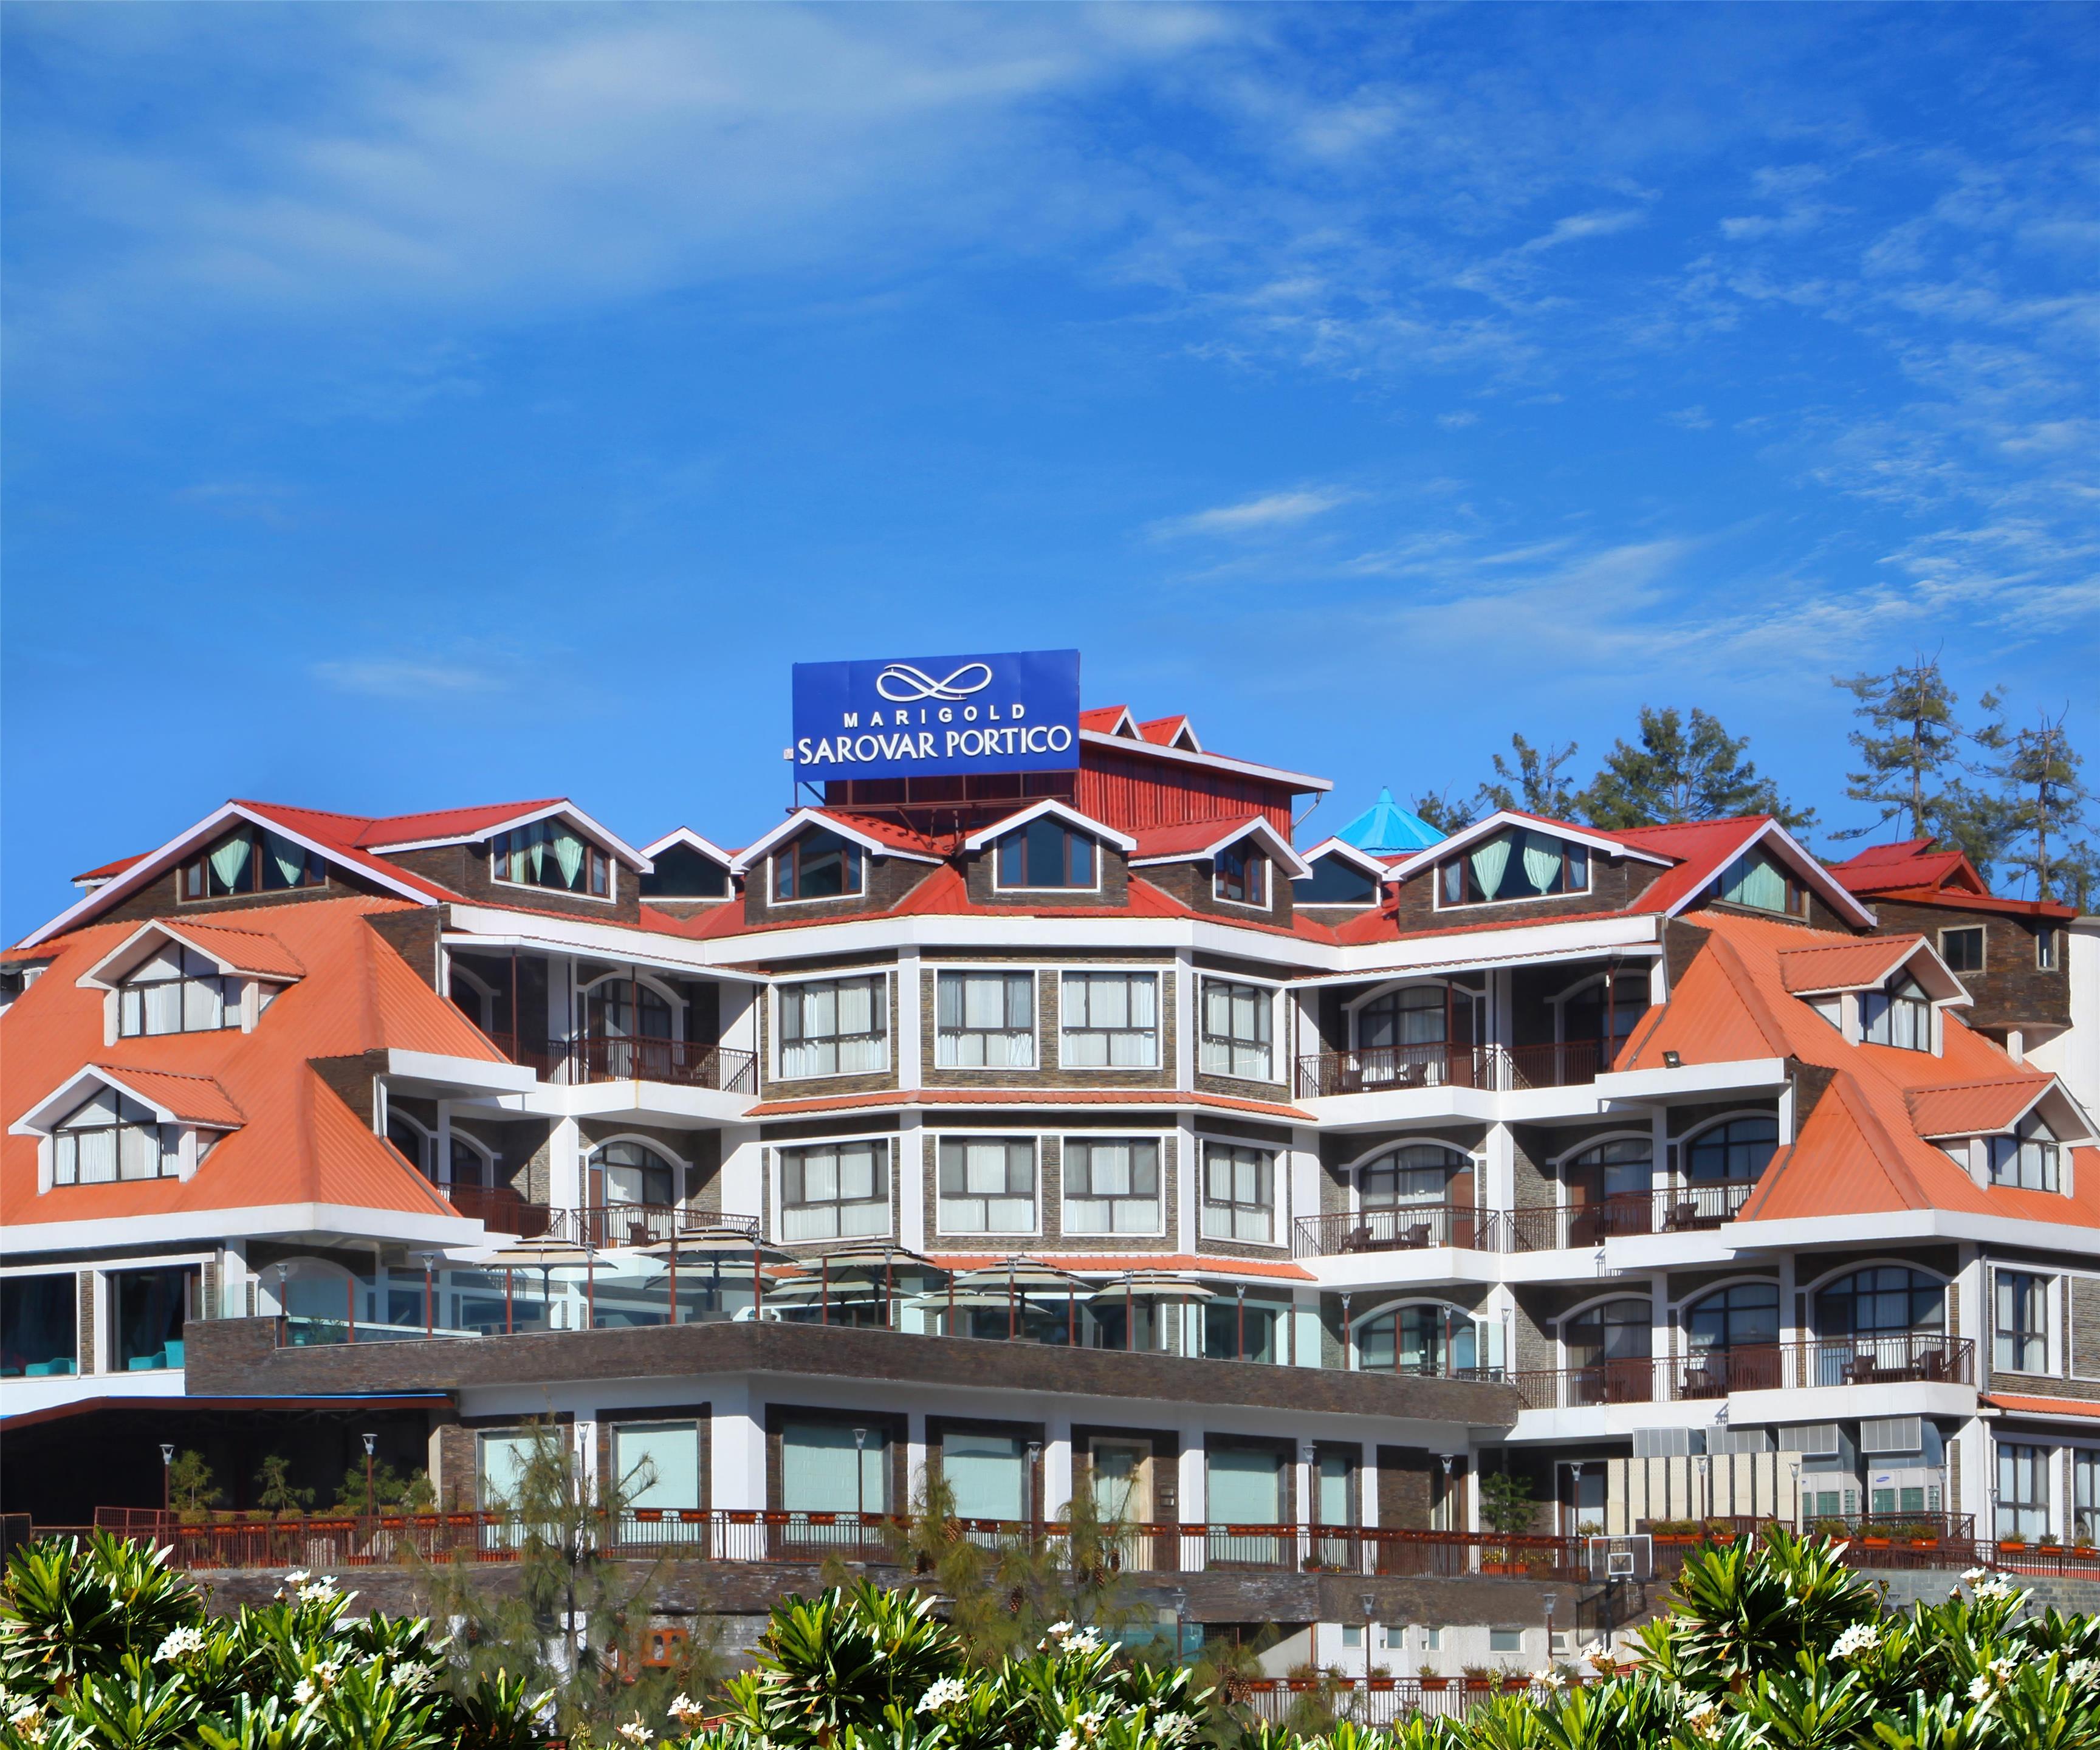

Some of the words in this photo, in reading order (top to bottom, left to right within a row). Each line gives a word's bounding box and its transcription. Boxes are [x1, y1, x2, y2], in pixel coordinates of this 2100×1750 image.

[843, 704, 1026, 728] MARIGOLD
[798, 732, 939, 765] SAROVAR
[946, 725, 1072, 758] PORTICO
